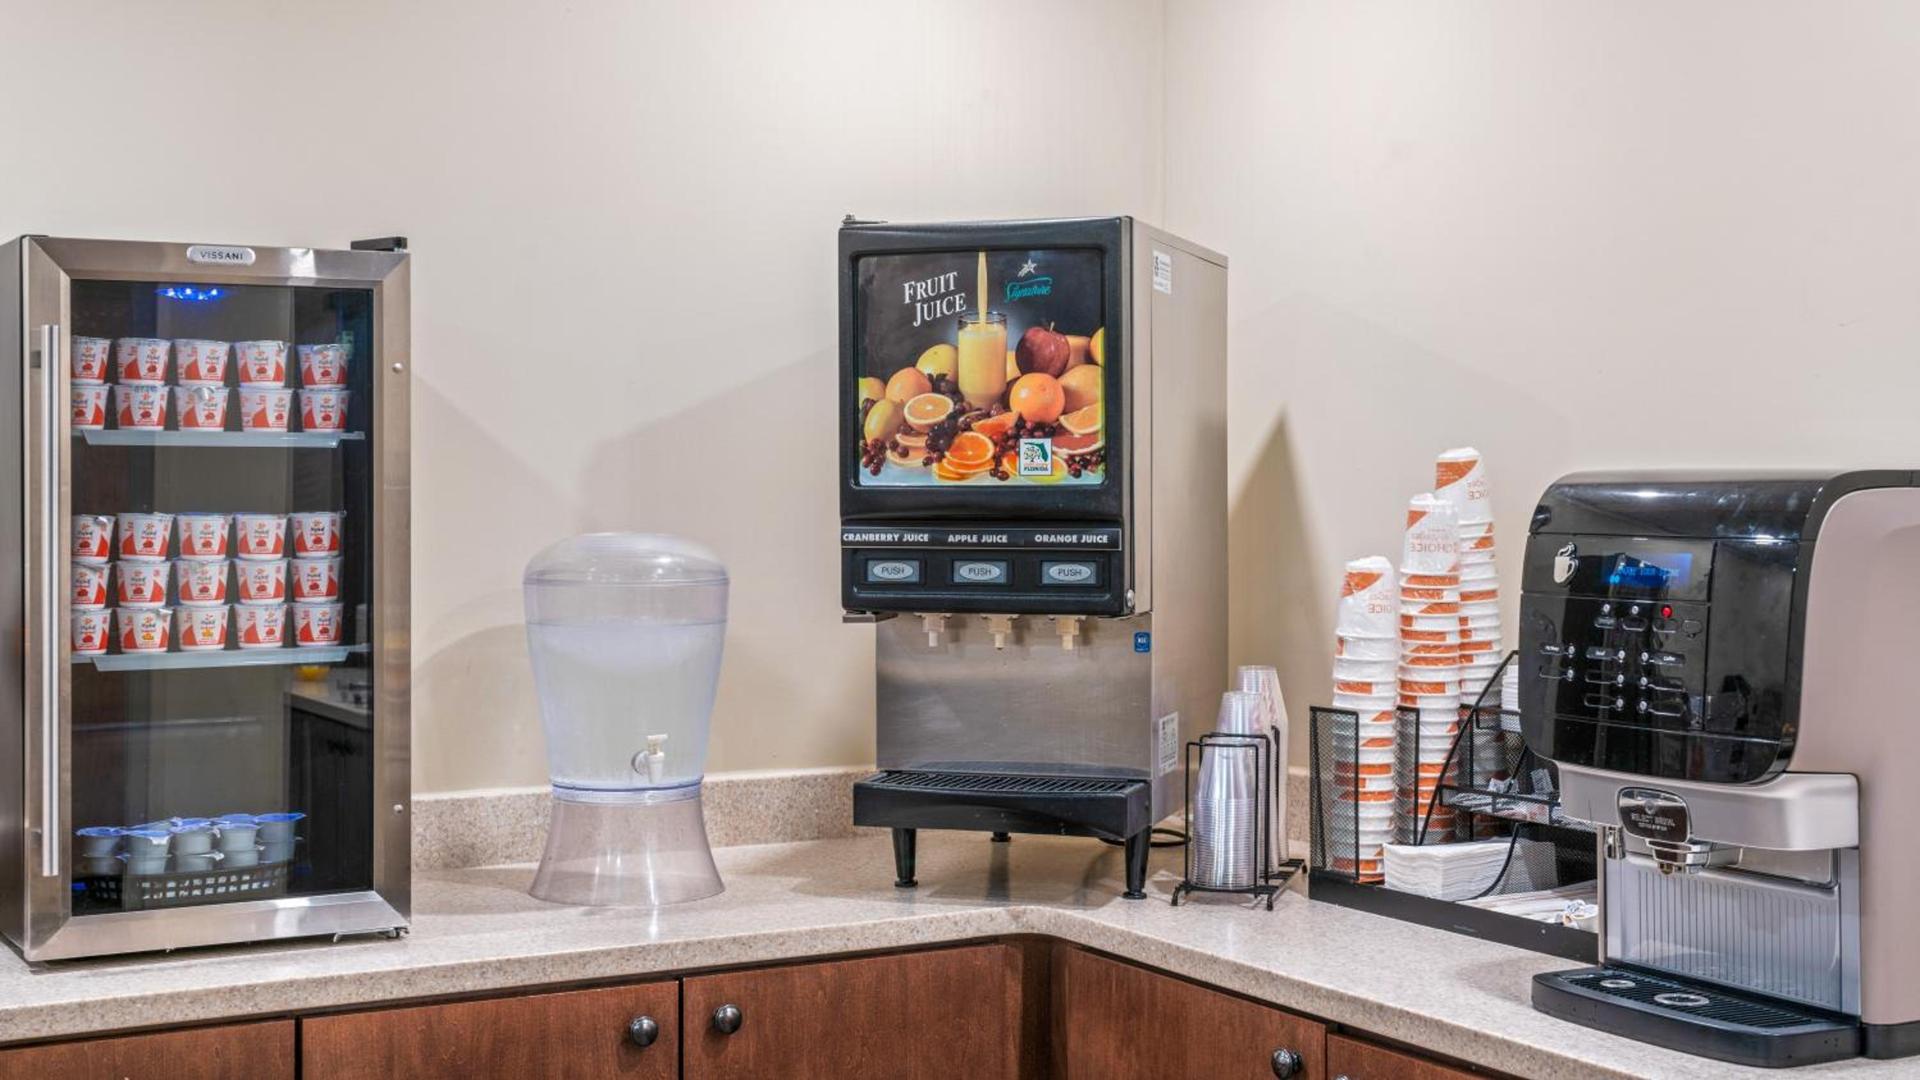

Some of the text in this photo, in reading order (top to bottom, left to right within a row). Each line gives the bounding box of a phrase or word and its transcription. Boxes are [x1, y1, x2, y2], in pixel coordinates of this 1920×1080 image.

[200, 251, 243, 260] VISSANI
[903, 271, 958, 304] FRUIT
[913, 293, 966, 327] JUICE
[842, 533, 929, 542] CRANBERRY JUICE
[947, 534, 1008, 543] APPLE JUICE
[1034, 534, 1109, 543] ORANGE JUICE
[881, 566, 905, 575] PUSH
[968, 567, 992, 576] PUSH
[1057, 567, 1082, 577] PUSH
